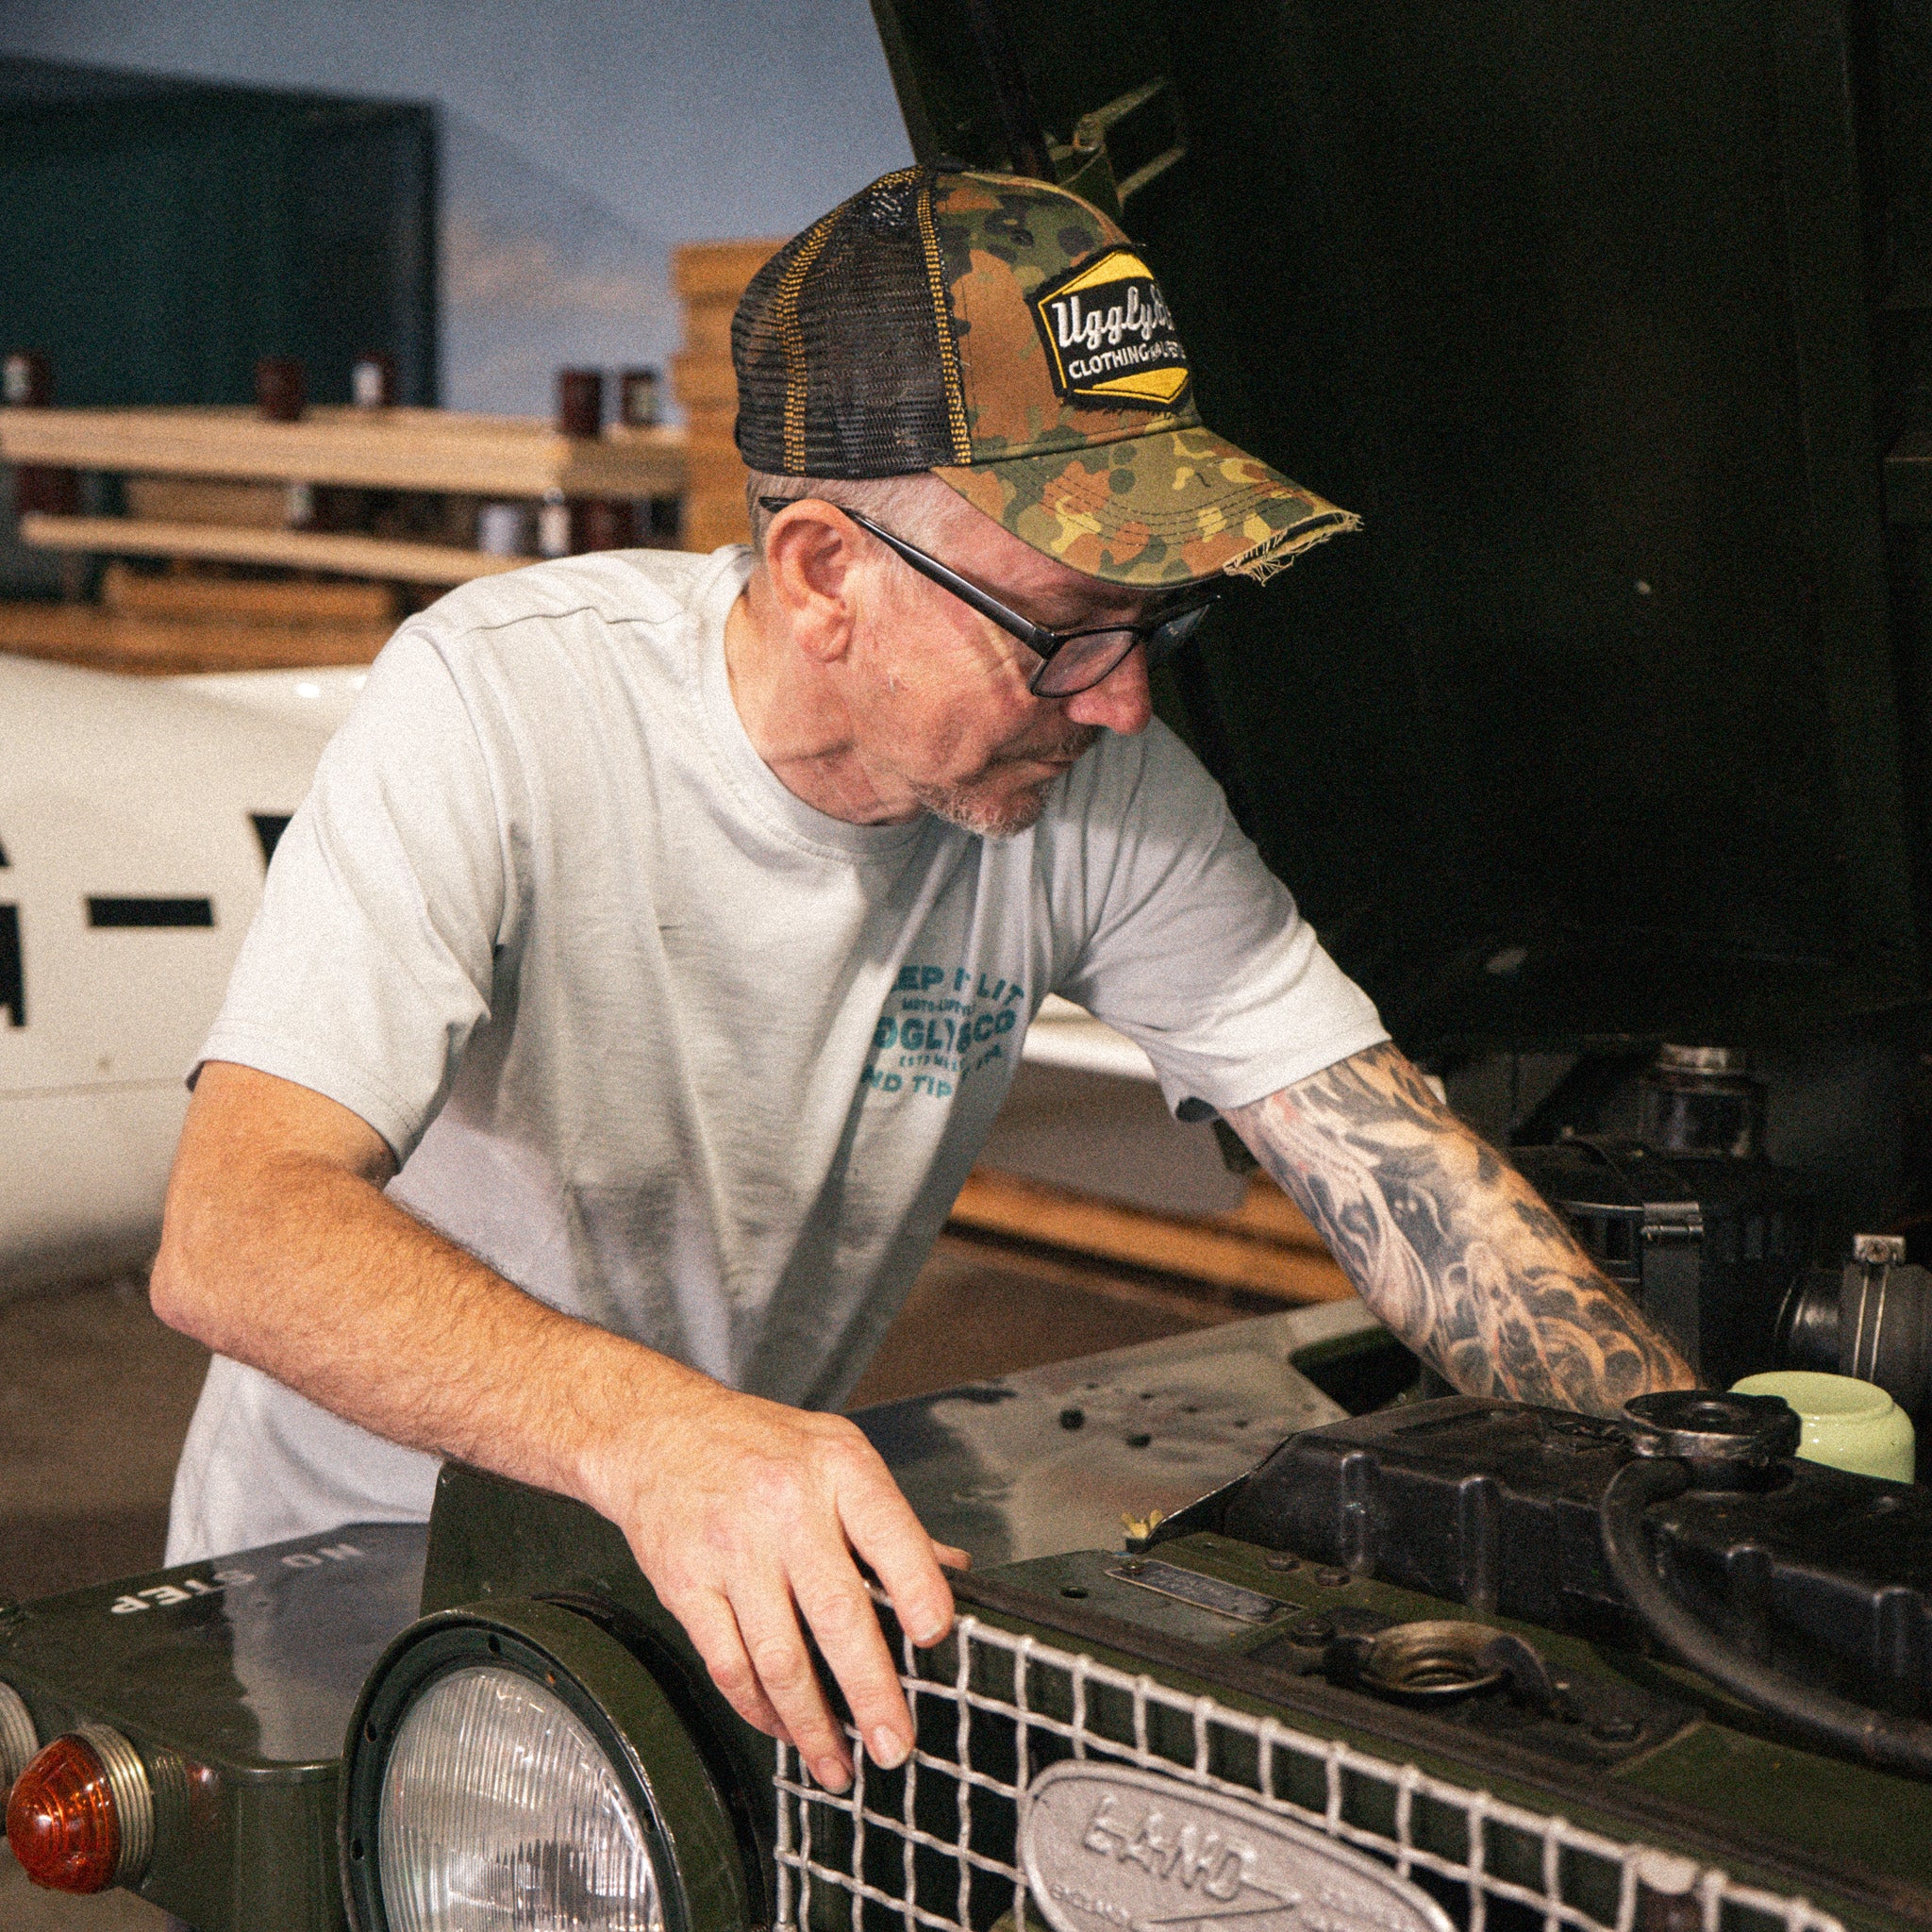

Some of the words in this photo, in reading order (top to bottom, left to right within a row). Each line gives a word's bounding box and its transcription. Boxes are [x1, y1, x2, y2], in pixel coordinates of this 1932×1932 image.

[1068, 342, 1148, 379] CLOTHING
[976, 973, 1024, 1006] LIT
[281, 1542, 366, 1568] NO
[110, 1570, 257, 1614] STEP
[1081, 1793, 1257, 1902] LAND
